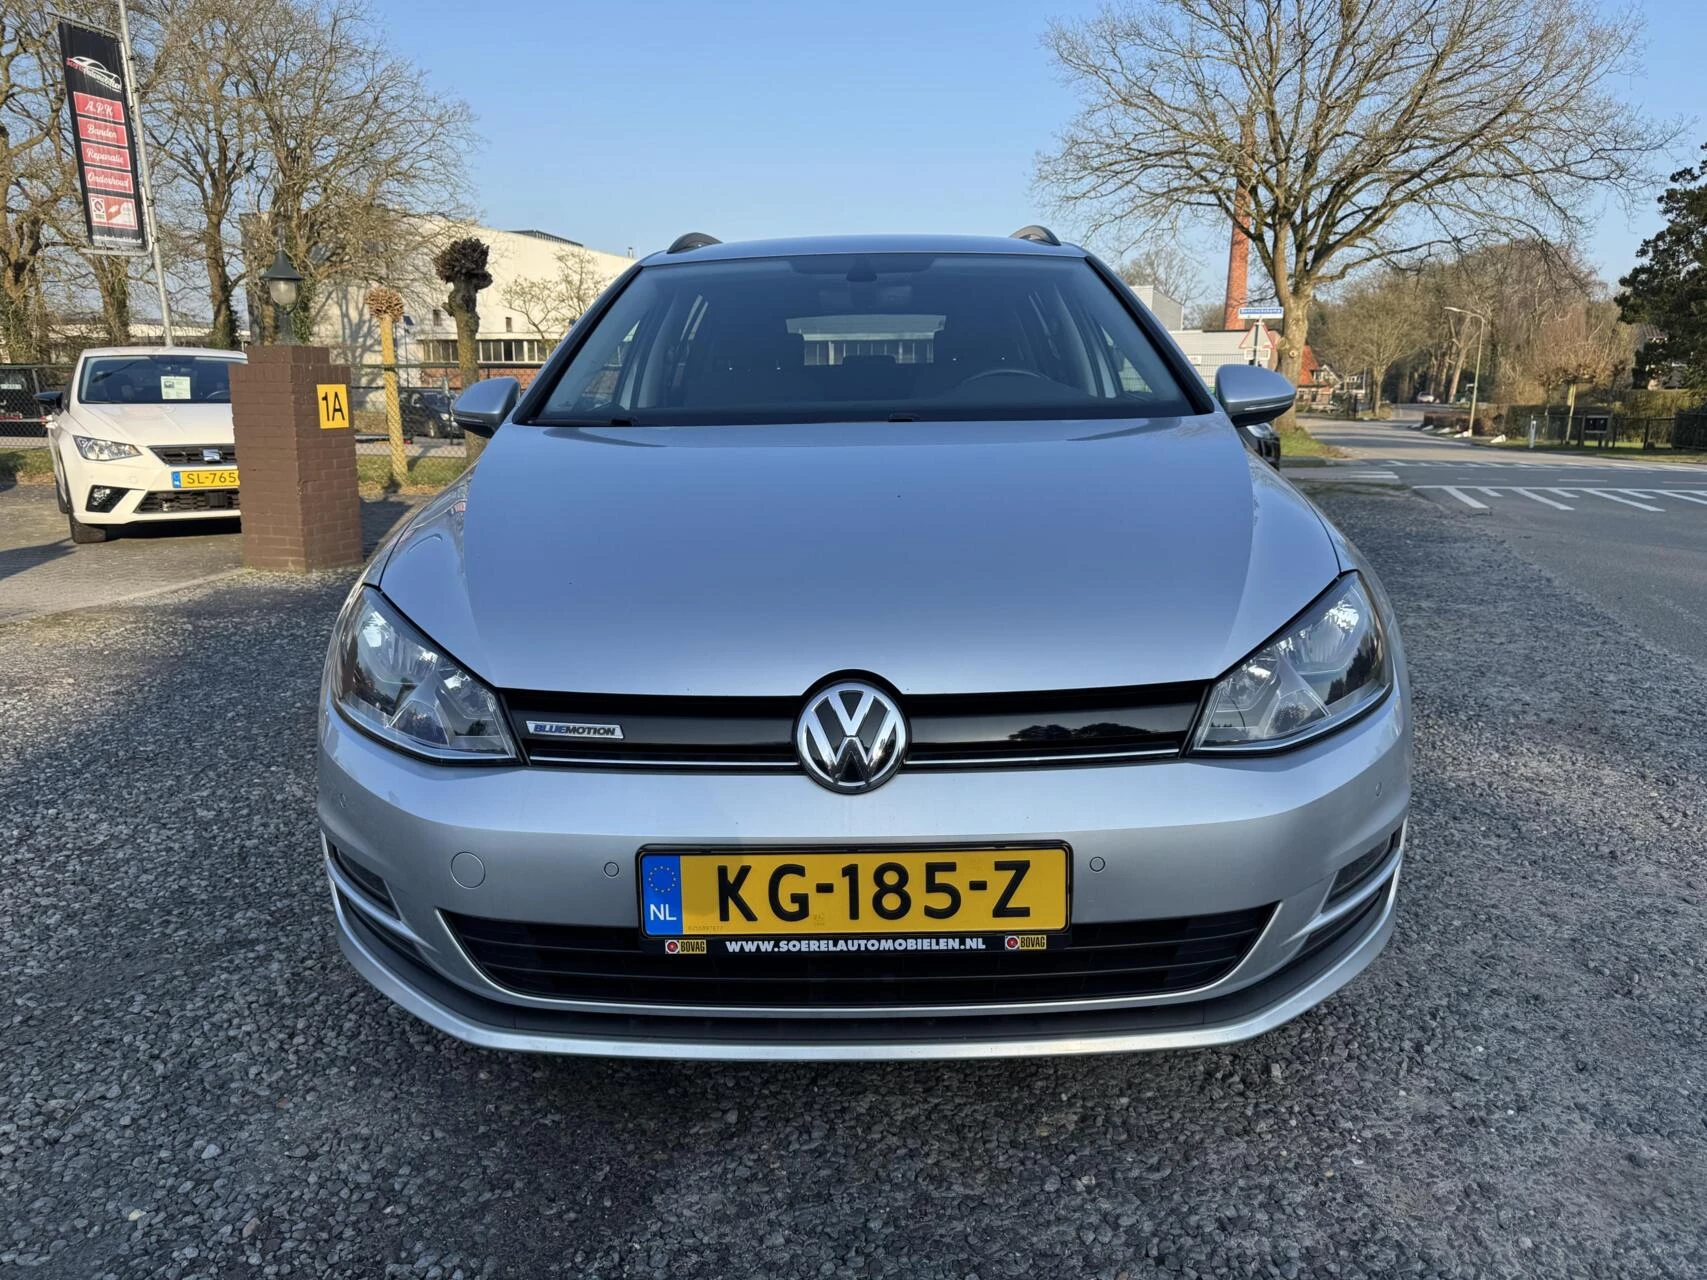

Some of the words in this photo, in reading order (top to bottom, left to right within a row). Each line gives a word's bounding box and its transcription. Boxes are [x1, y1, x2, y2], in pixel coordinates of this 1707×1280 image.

[321, 391, 346, 422] 1A
[533, 723, 616, 736] BLUEMOTION
[717, 859, 1031, 922] KG-185-Z
[649, 903, 677, 921] NL
[680, 940, 705, 953] BOVAG
[725, 937, 986, 953] WWW.SOERELAUTOMOBIELEN.NL
[1020, 936, 1046, 948] BOVAG
